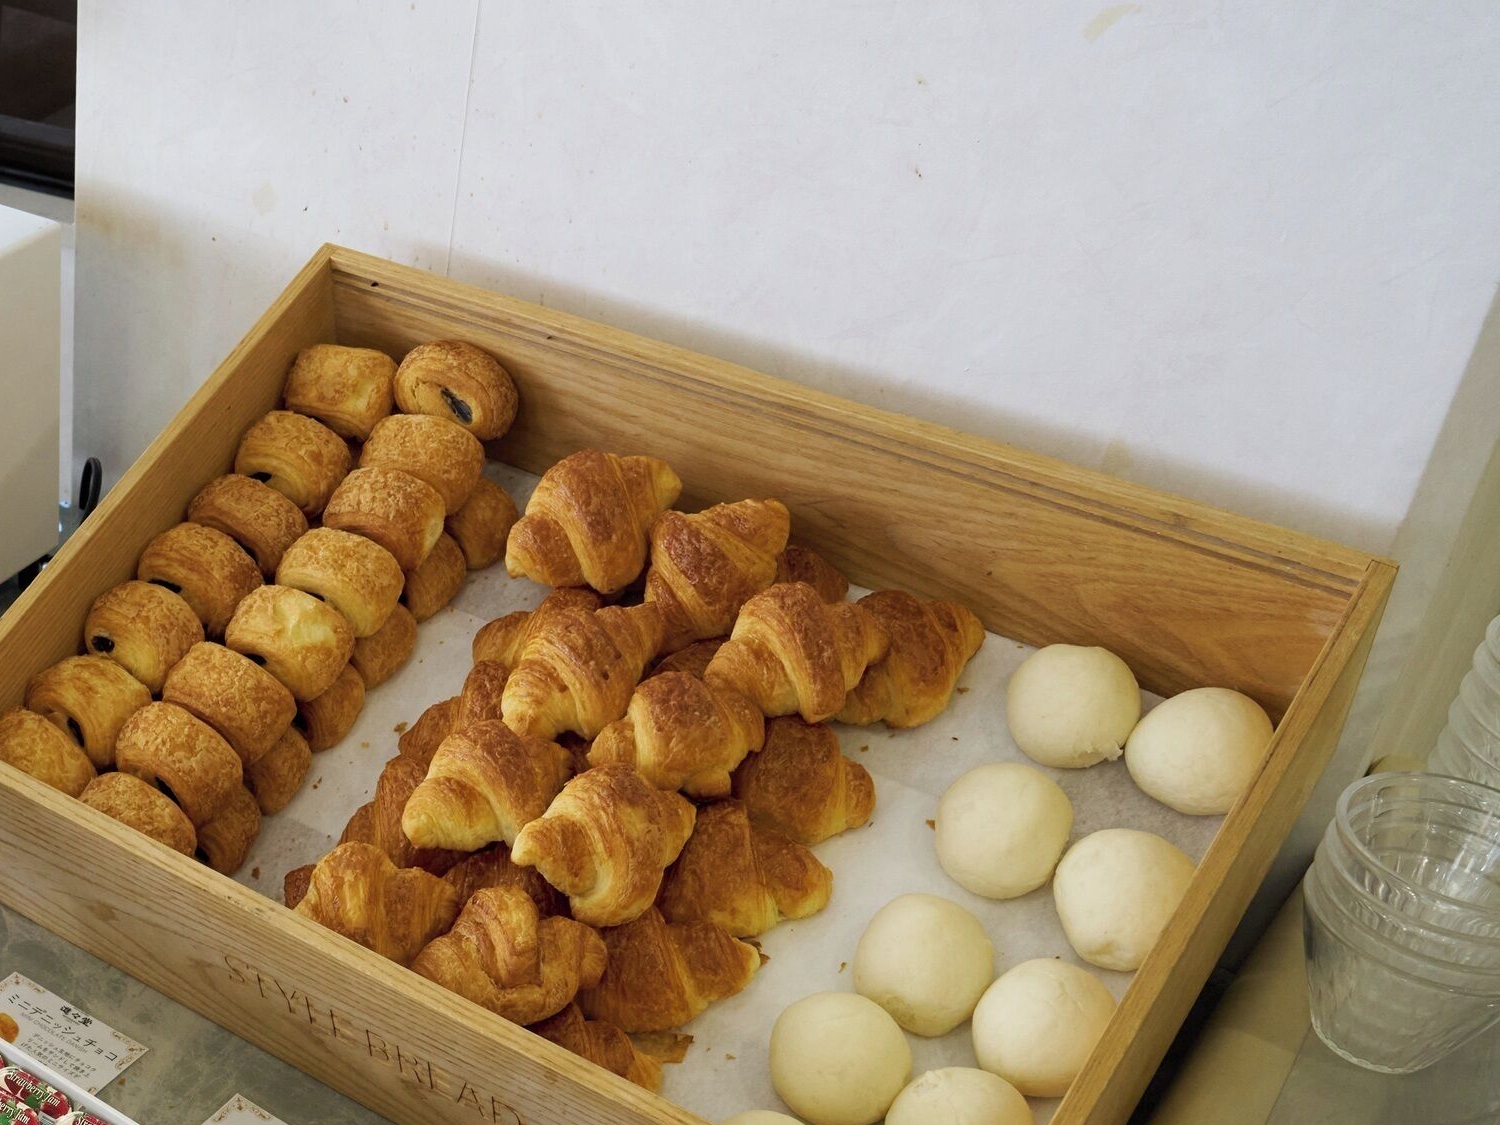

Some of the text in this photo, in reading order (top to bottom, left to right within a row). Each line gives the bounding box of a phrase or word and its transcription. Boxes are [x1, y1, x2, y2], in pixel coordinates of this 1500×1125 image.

[224, 951, 353, 1043] STYLE
[7, 993, 119, 1062] ミニデニッシュチョコ
[7, 1071, 60, 1107] Strawberry Jam
[14, 1108, 30, 1125] Jam
